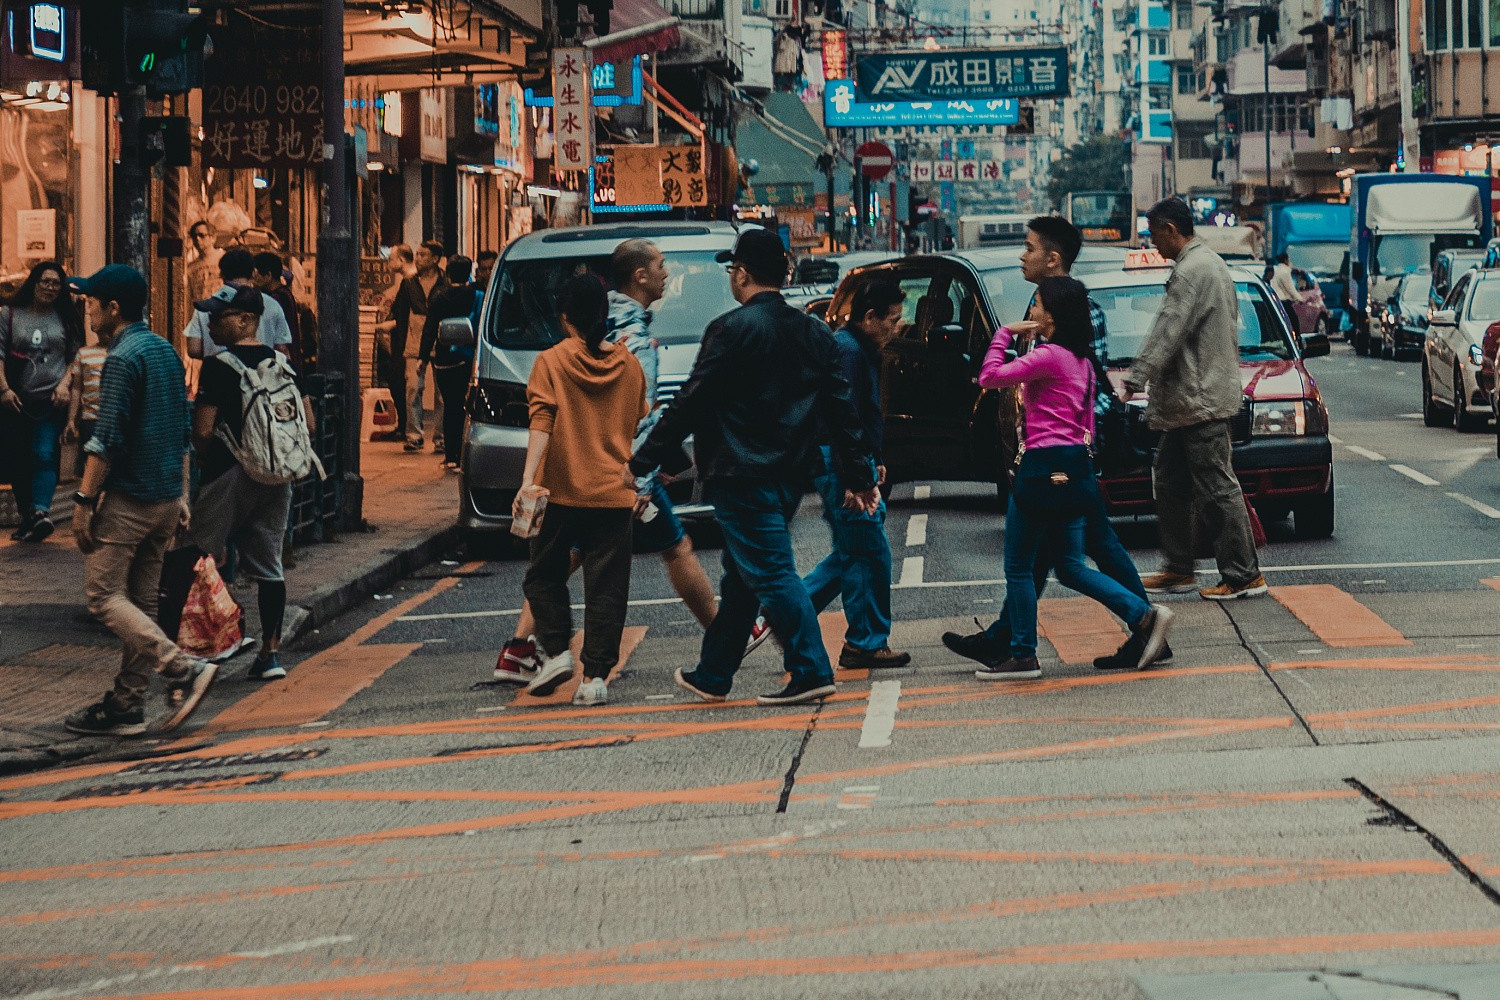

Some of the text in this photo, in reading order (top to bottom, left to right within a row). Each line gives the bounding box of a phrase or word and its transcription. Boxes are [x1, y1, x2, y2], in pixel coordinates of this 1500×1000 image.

[930, 57, 1057, 86] 成田影音
[276, 85, 324, 114] 982
[559, 54, 581, 163] 永生水電
